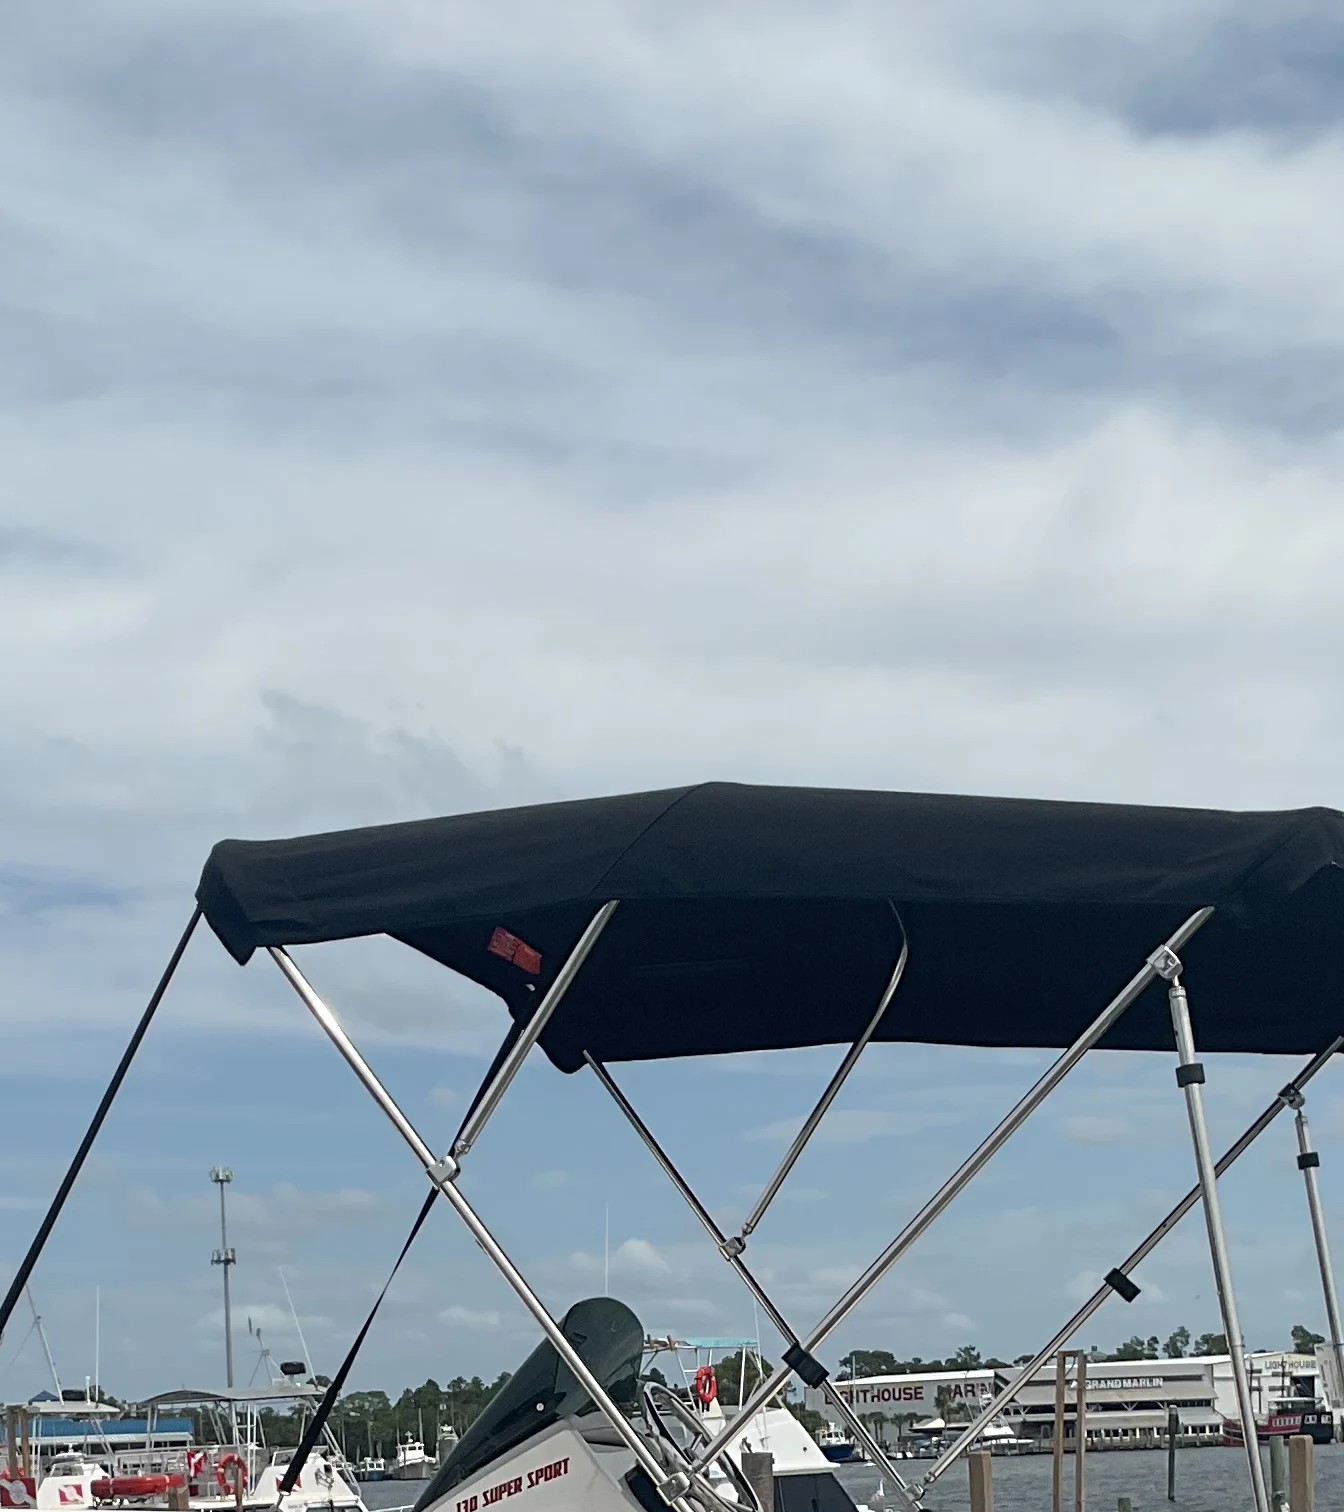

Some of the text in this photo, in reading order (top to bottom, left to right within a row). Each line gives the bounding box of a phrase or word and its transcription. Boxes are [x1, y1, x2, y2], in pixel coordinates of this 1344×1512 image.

[1085, 1377, 1164, 1390] GRAND MARLIN
[824, 1386, 924, 1405] LGHTHOUSE
[482, 1476, 523, 1507] SUPER
[527, 1457, 570, 1489] SPORT
